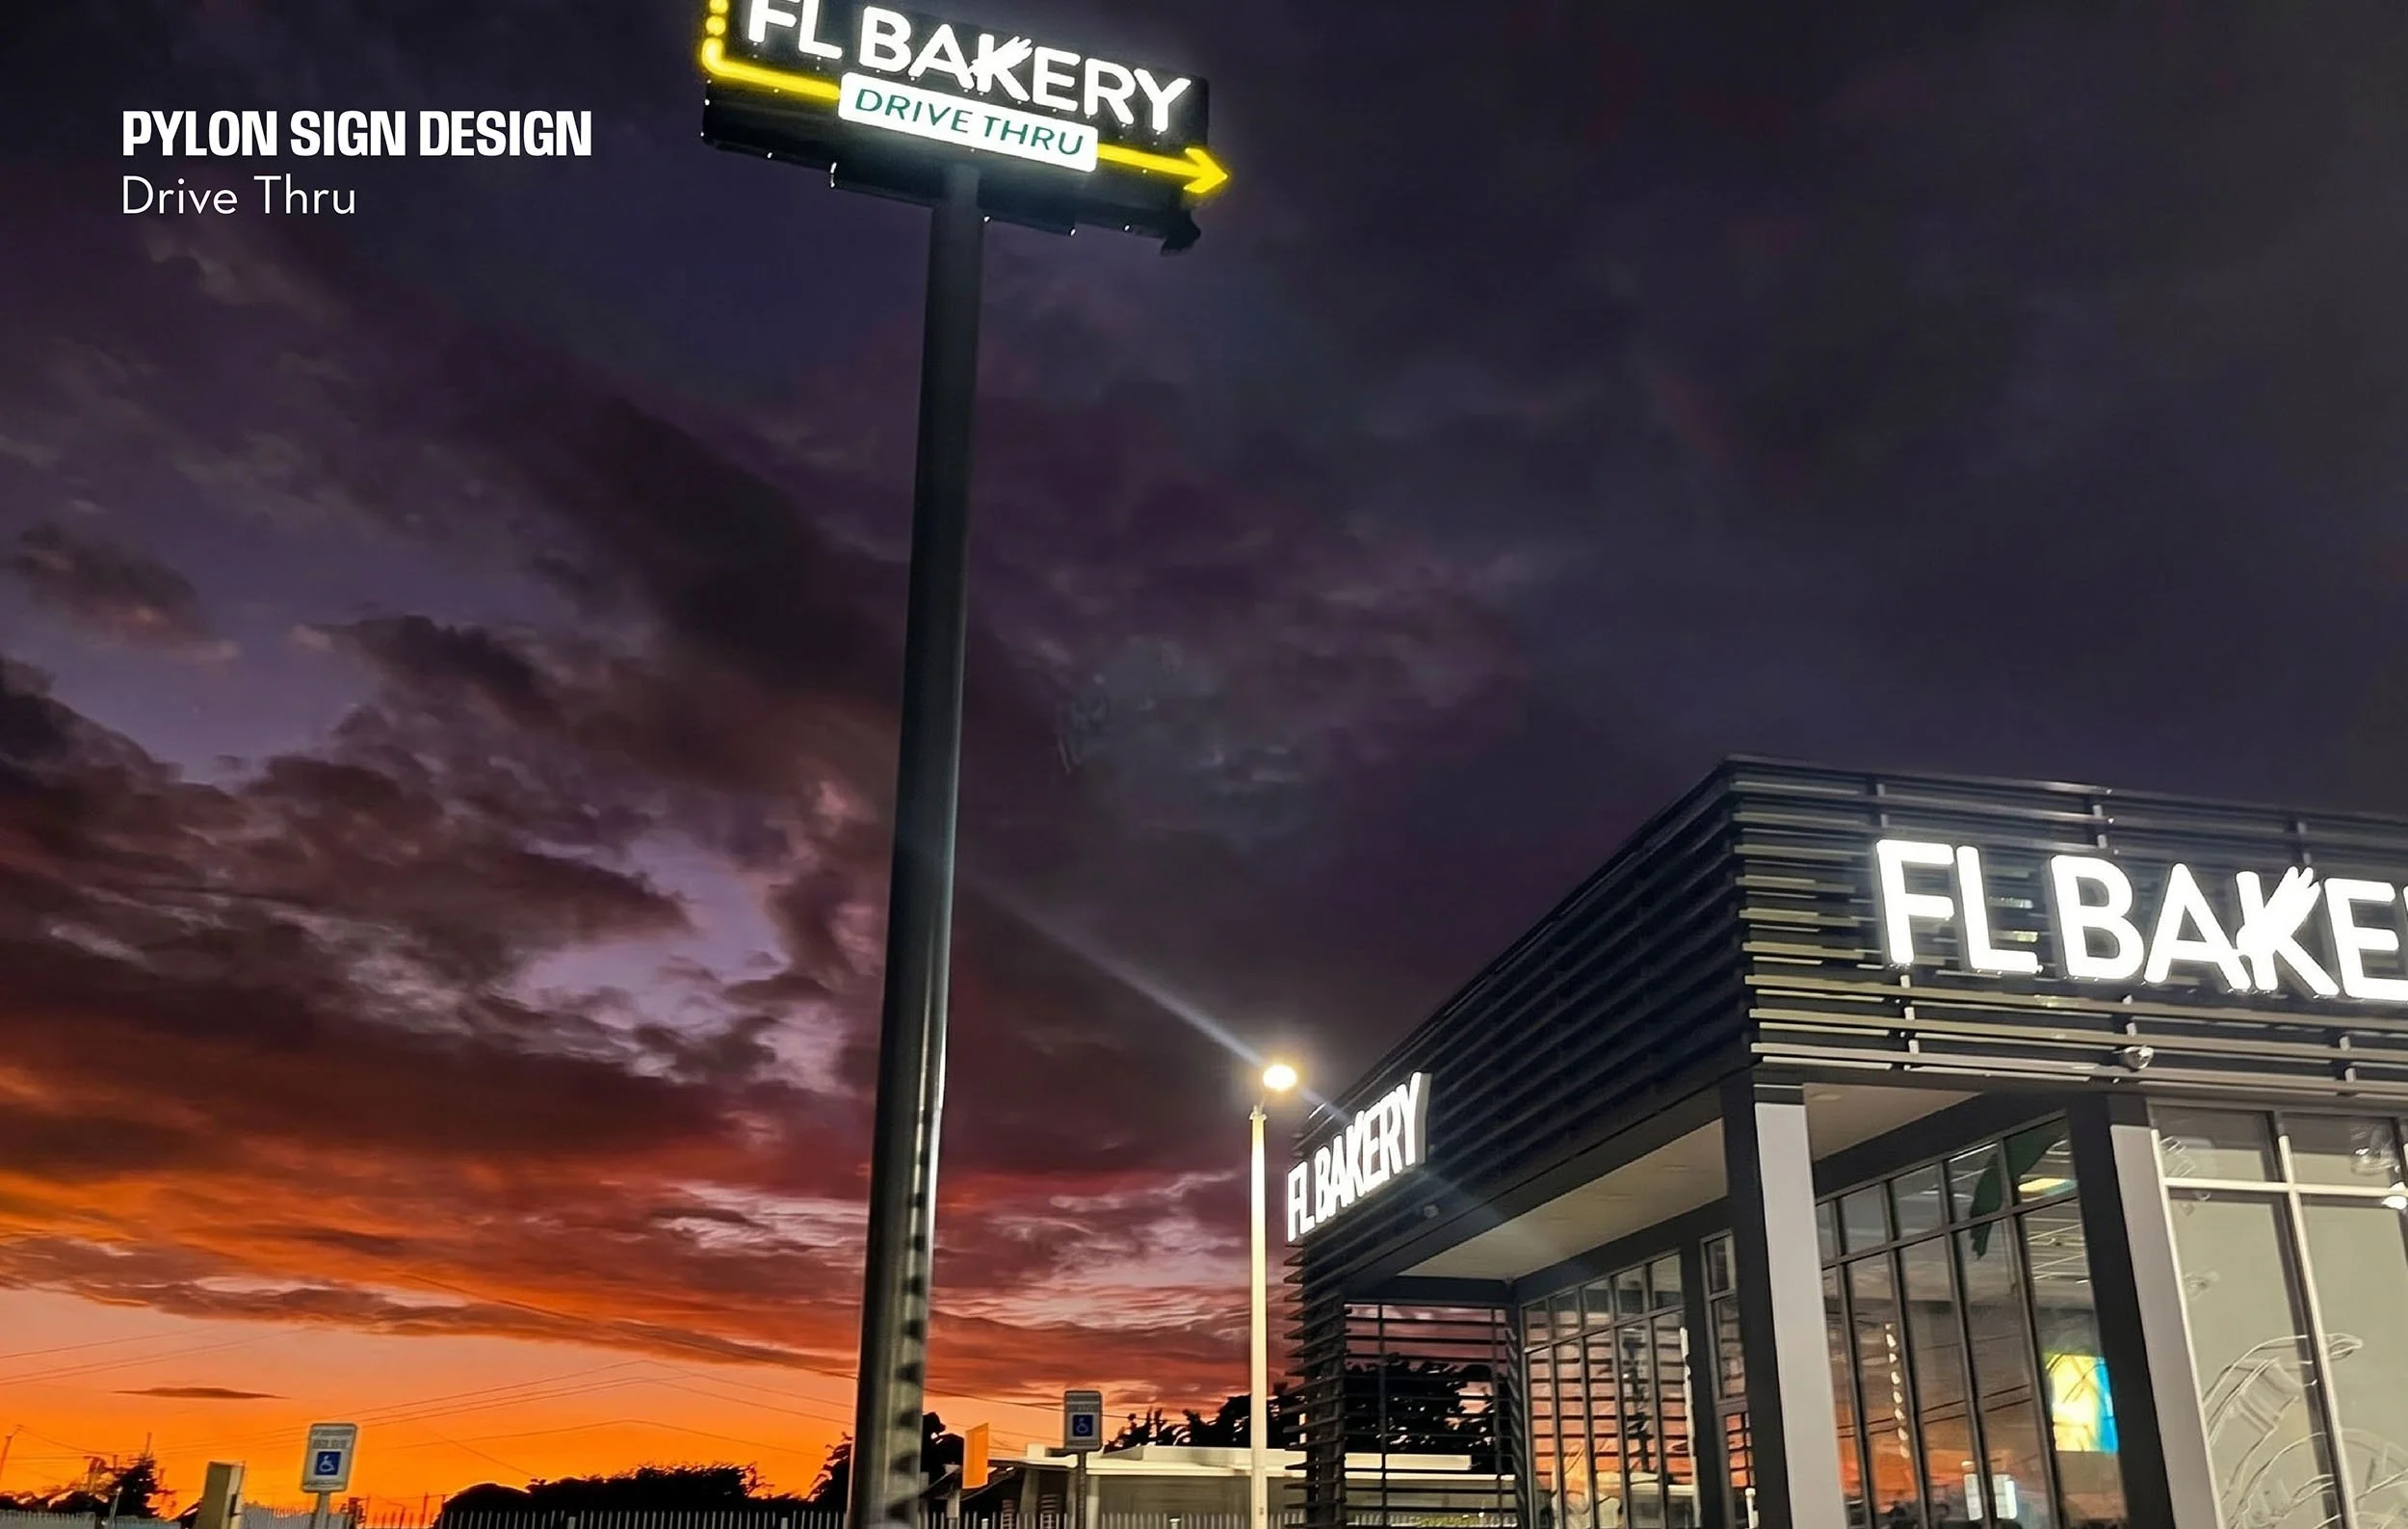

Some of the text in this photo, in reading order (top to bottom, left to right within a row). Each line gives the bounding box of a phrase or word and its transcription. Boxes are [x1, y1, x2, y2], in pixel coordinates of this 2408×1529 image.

[747, 0, 1191, 133] FL BAKERY
[854, 89, 1085, 156] DRIVE THRU
[1876, 839, 2408, 1002] FL BAKE
[1287, 1071, 1423, 1242] FL BAKERY
